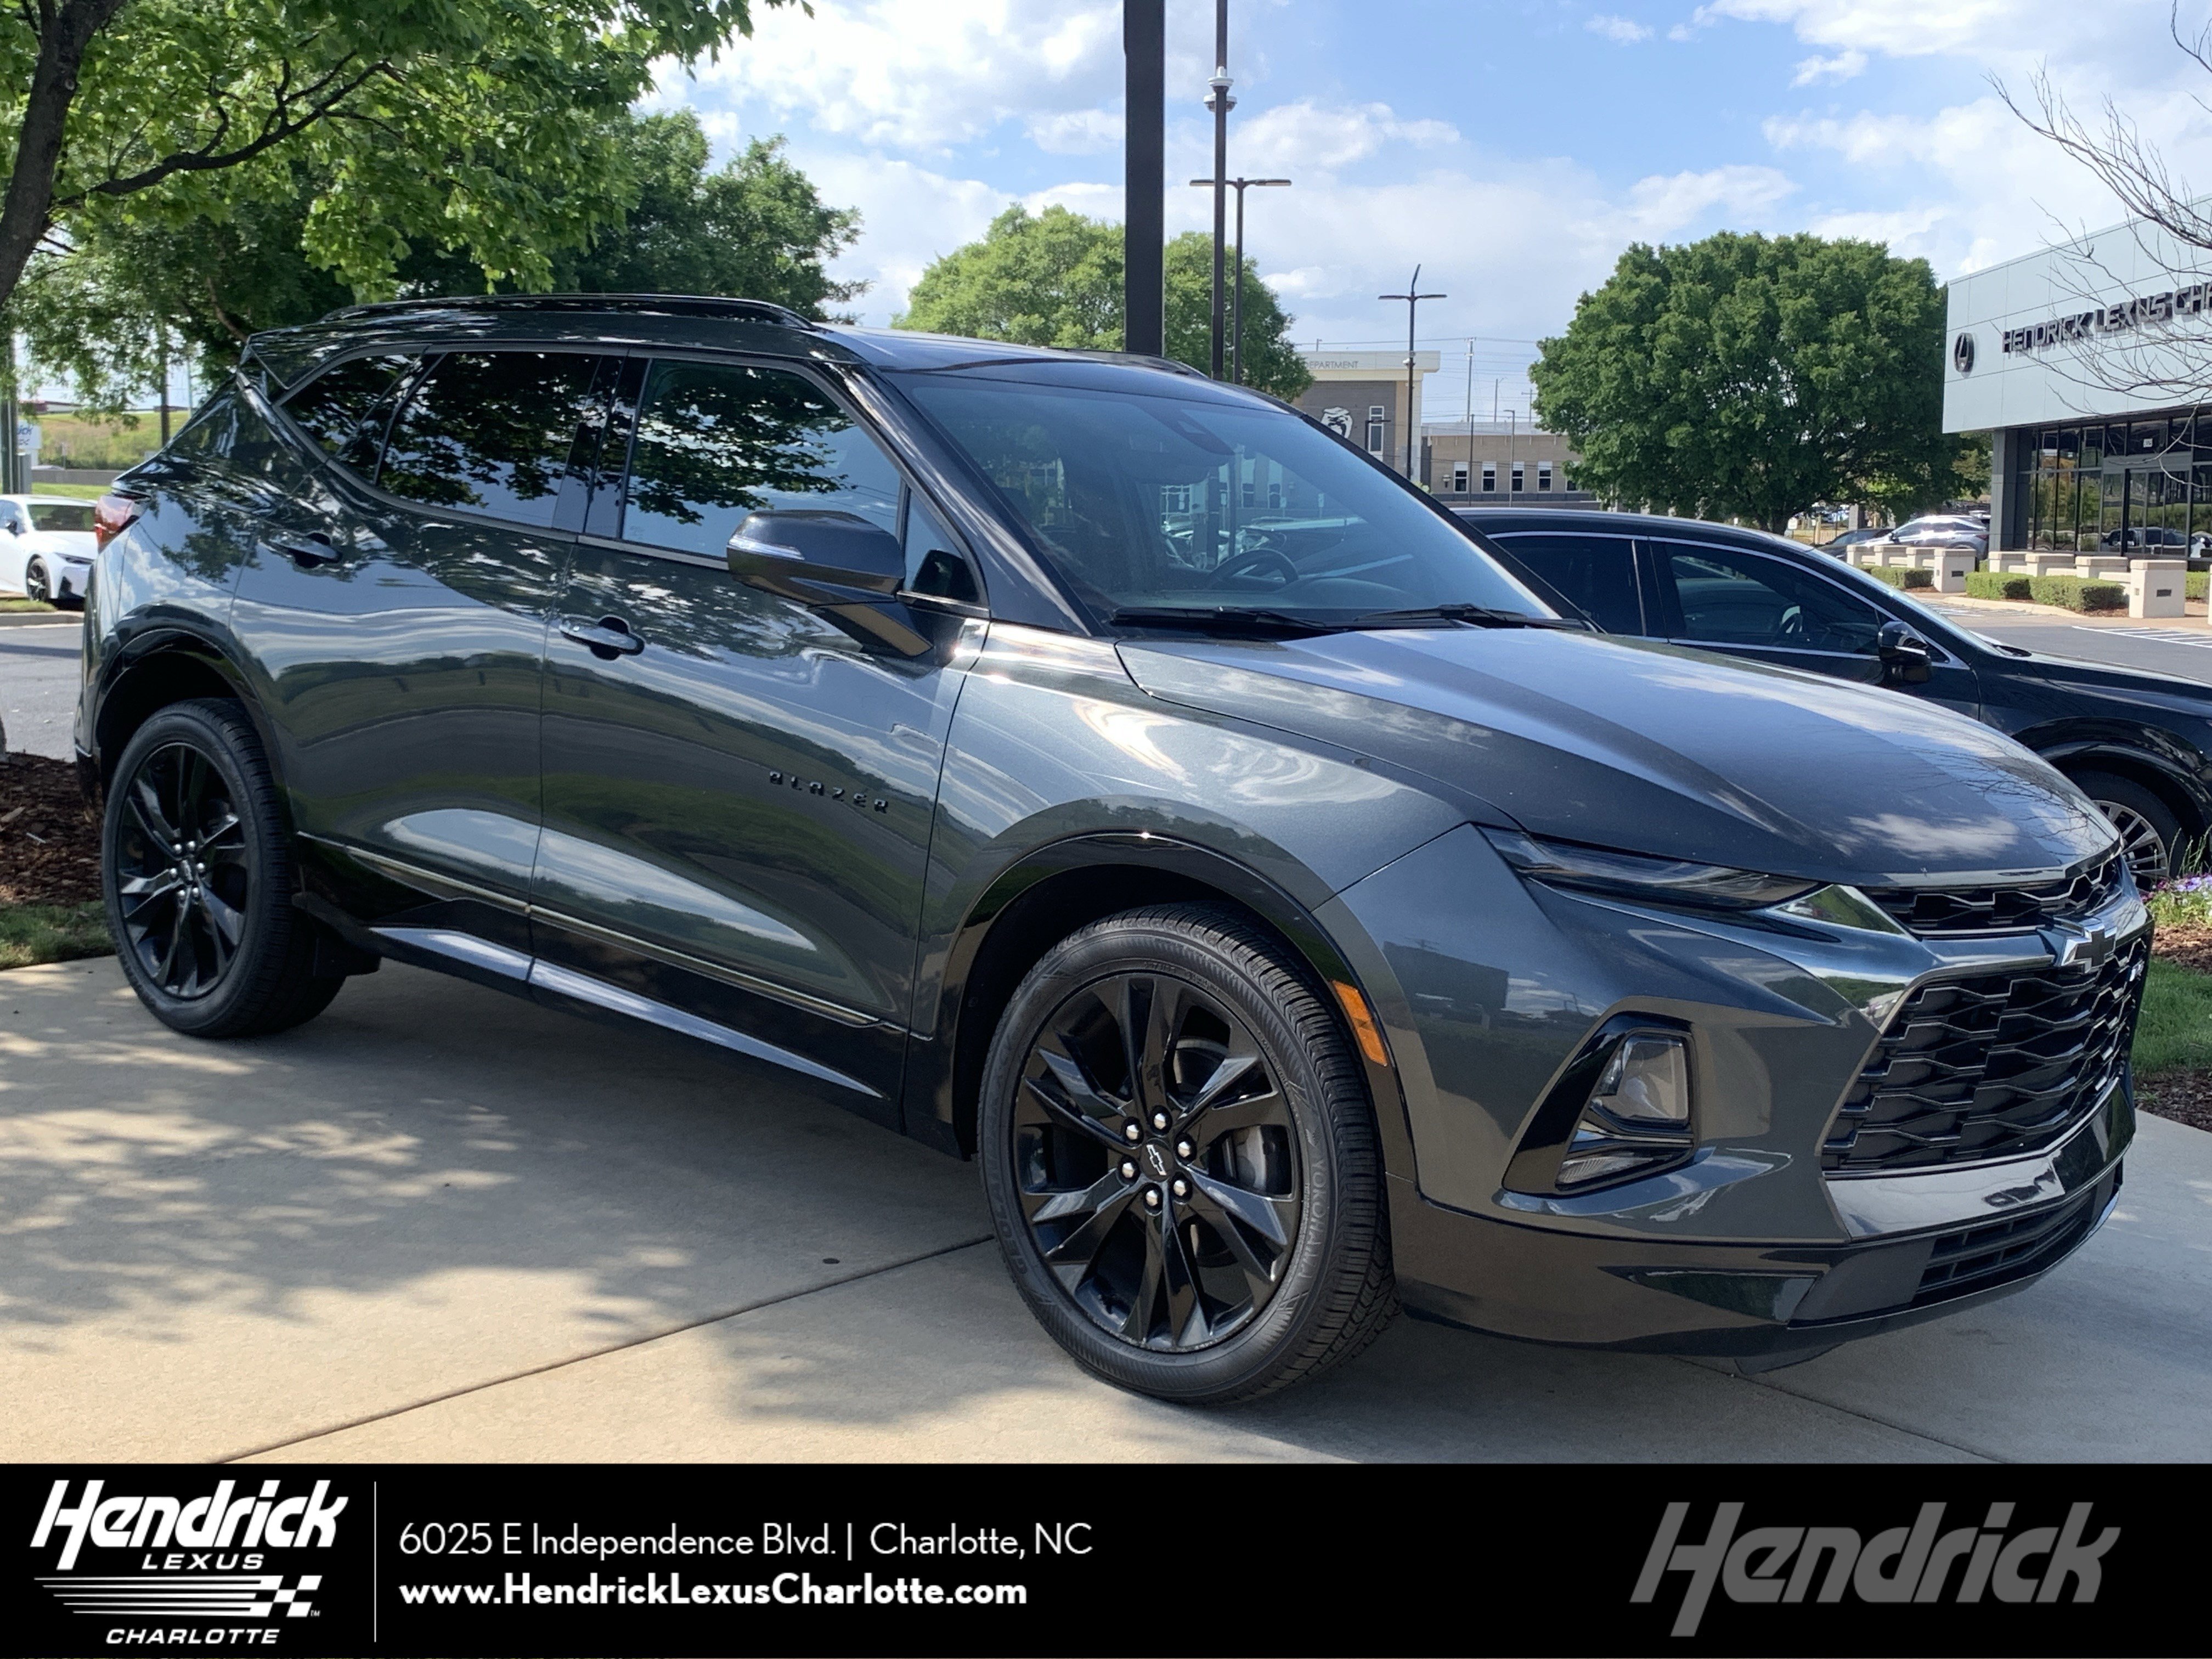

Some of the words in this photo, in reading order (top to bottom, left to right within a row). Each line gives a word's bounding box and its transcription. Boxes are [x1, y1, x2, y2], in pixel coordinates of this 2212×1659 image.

[2002, 312, 2094, 353] HENDRICK
[2094, 292, 2173, 332] LEXUS
[769, 770, 889, 814] BLAZER
